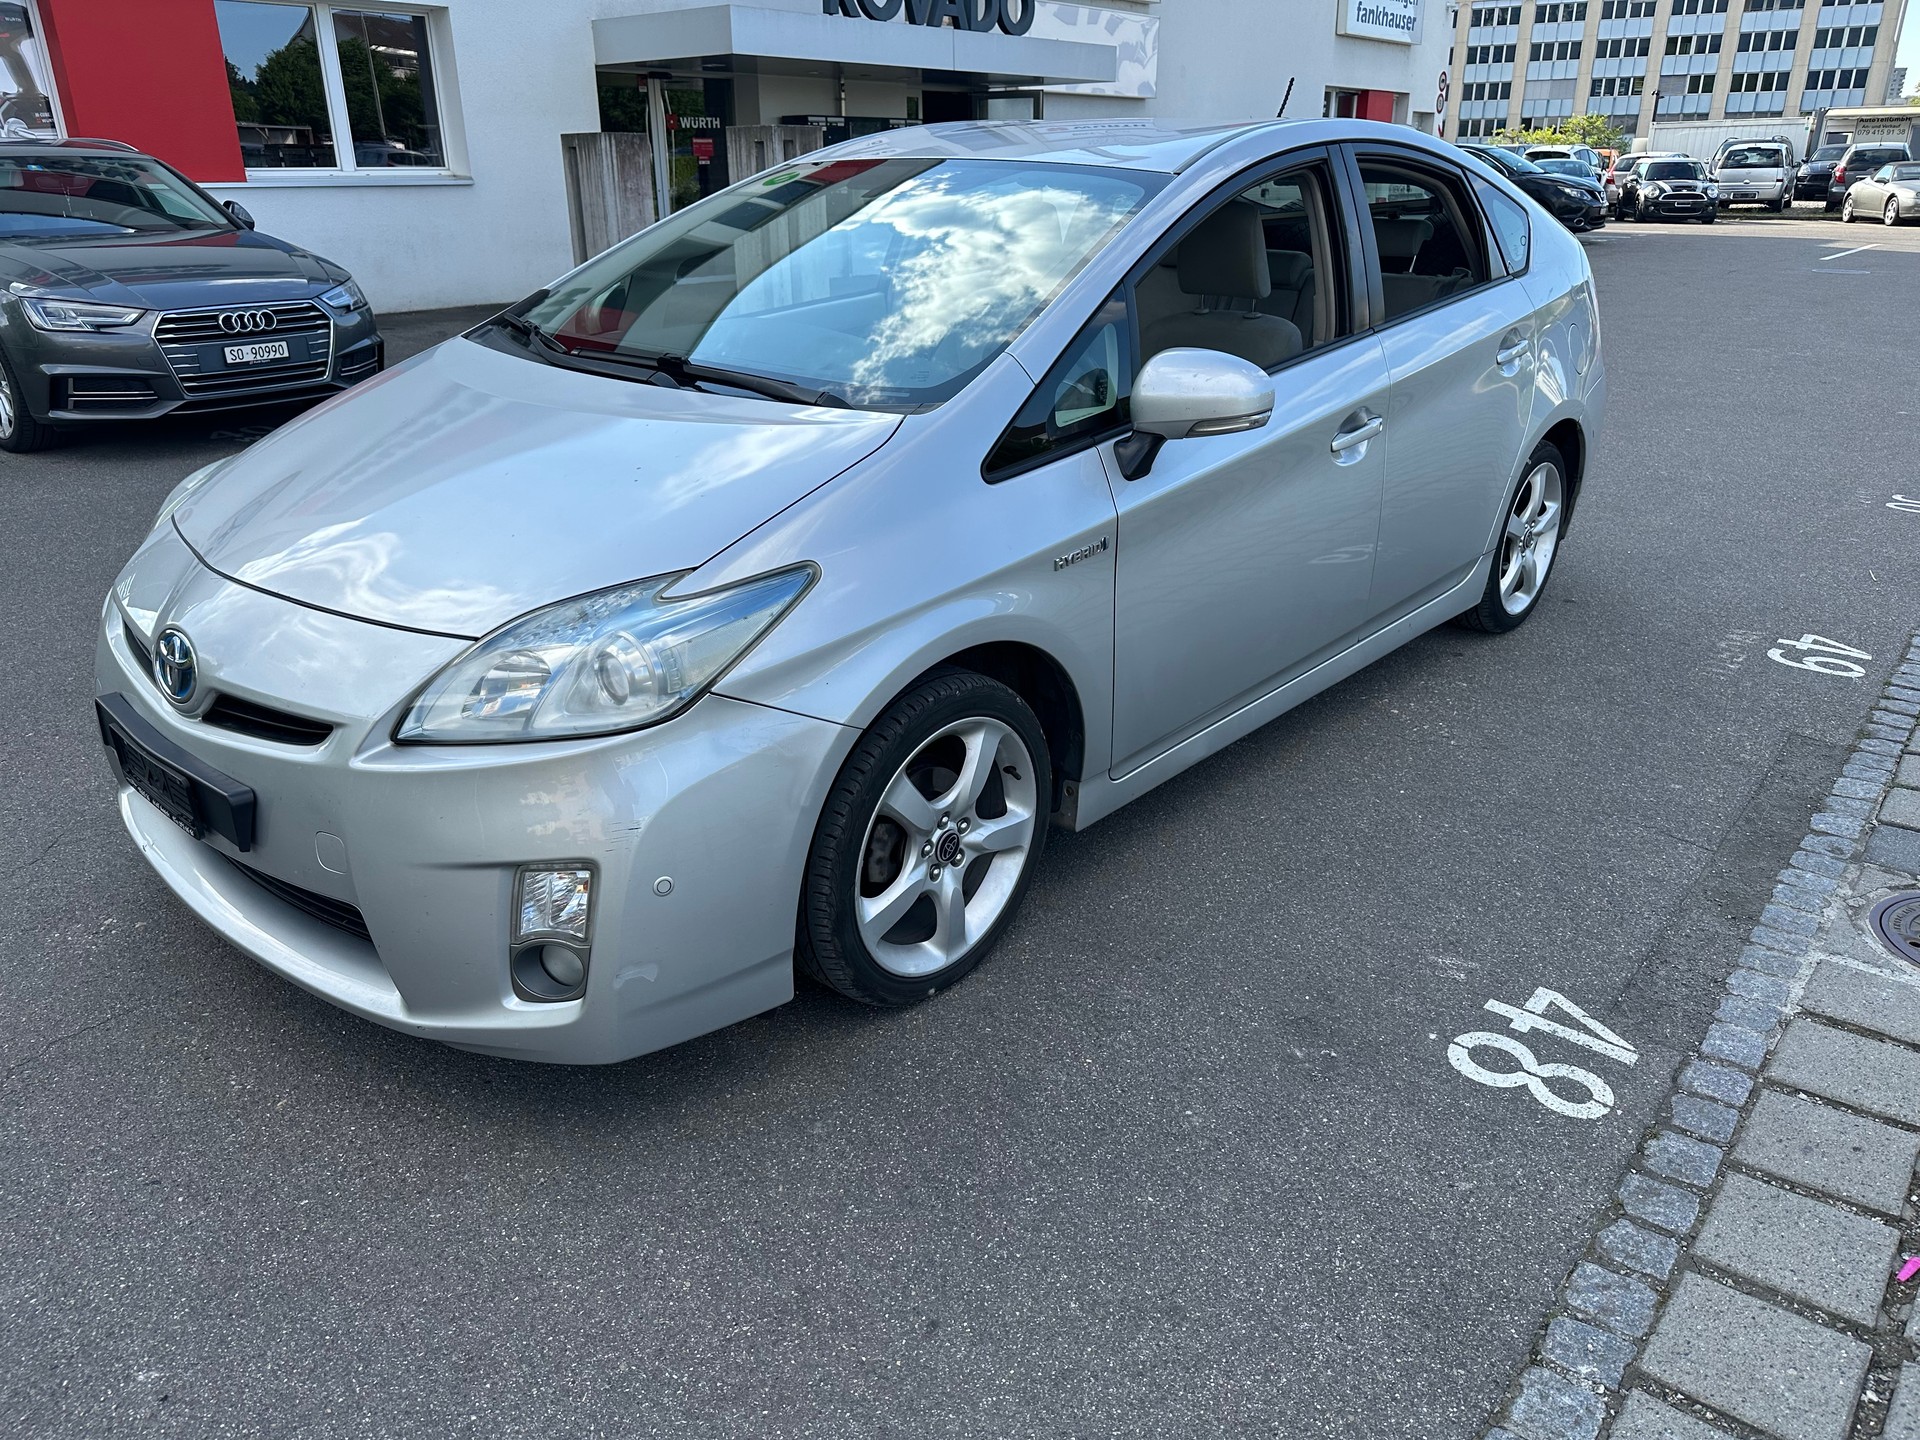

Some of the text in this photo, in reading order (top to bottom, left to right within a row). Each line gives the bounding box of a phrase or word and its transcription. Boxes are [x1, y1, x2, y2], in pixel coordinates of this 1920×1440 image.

[1356, 1, 1417, 32] fankhauser
[680, 117, 720, 129] WÜRTH
[1054, 539, 1102, 572] HYBRID
[1766, 633, 1873, 678] 49
[1447, 986, 1641, 1120] 48
